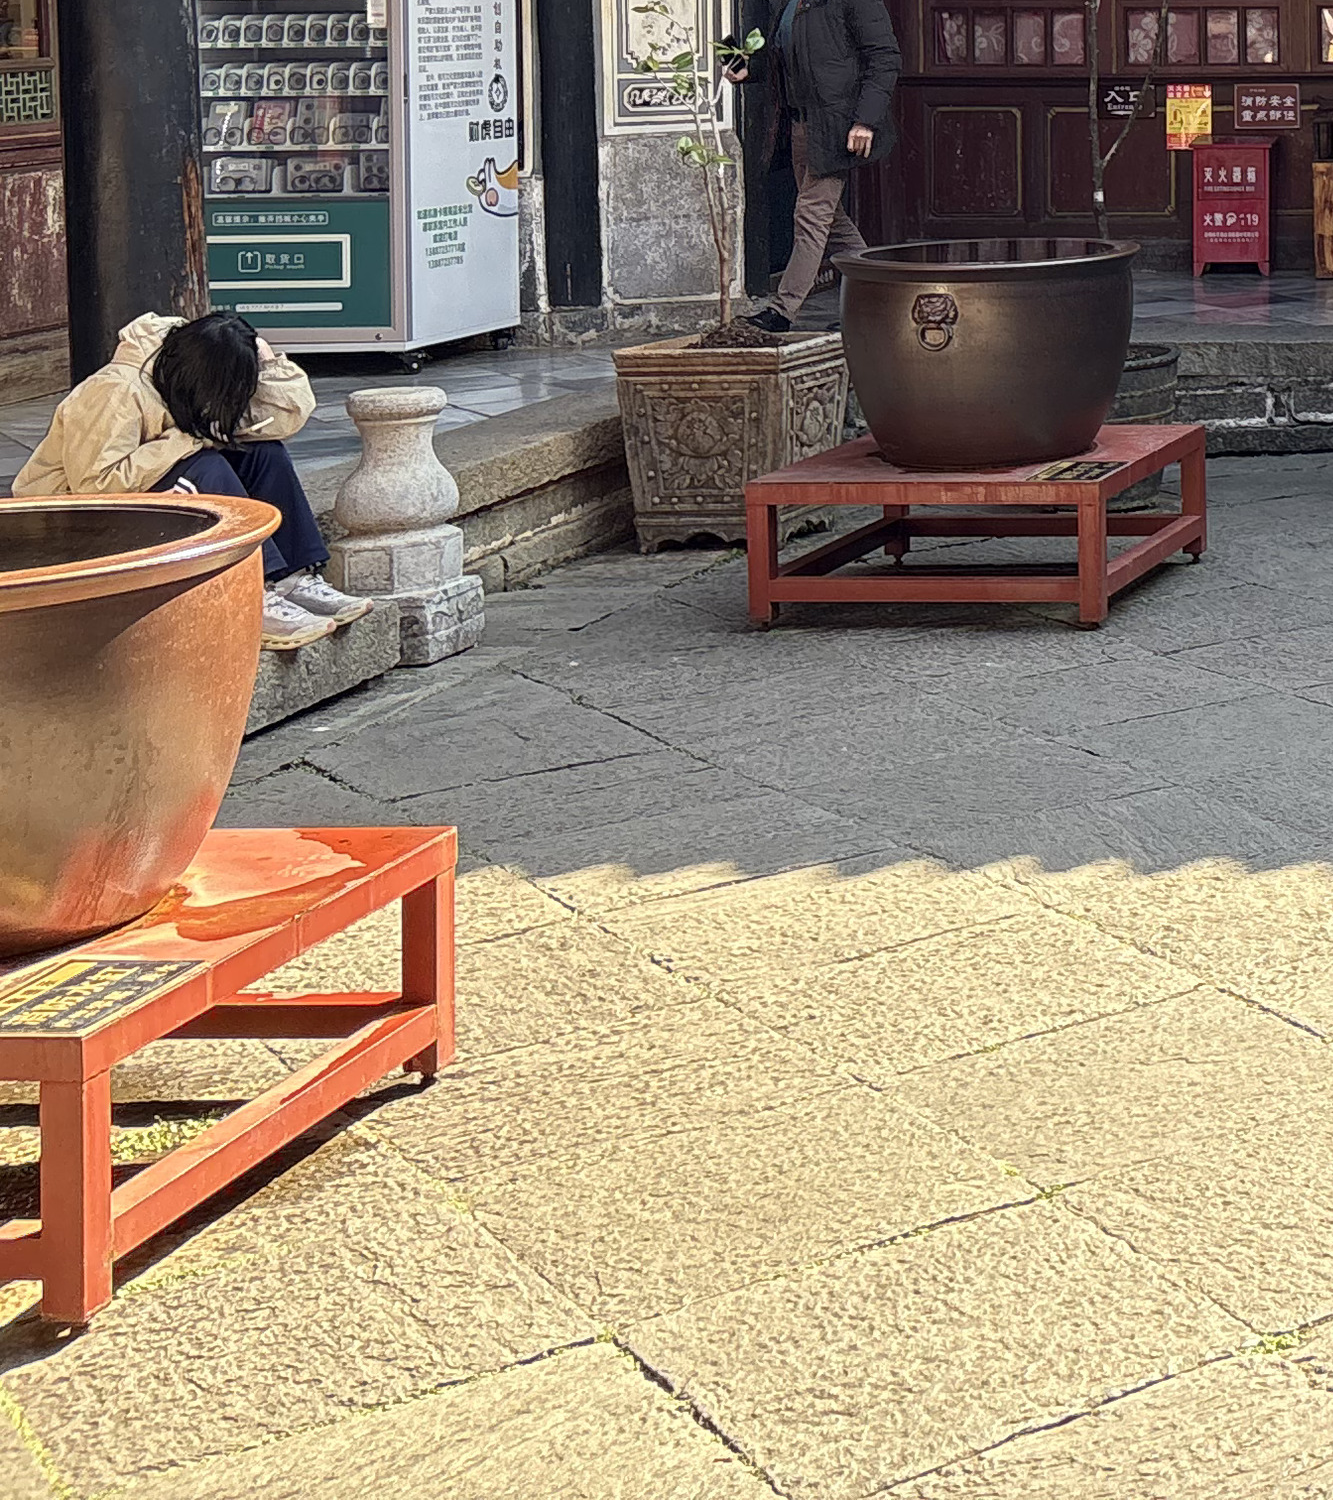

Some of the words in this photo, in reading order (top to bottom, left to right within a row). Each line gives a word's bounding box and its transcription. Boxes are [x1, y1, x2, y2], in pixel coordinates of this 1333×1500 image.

[1103, 90, 1142, 103] 入口
[1241, 95, 1296, 107] 消防安全
[1107, 103, 1144, 111] Entrane
[1241, 109, 1296, 122] 重点部位
[1203, 166, 1256, 183] 灭火器箱
[1239, 213, 1259, 226] 119
[265, 253, 305, 264] 取货口
